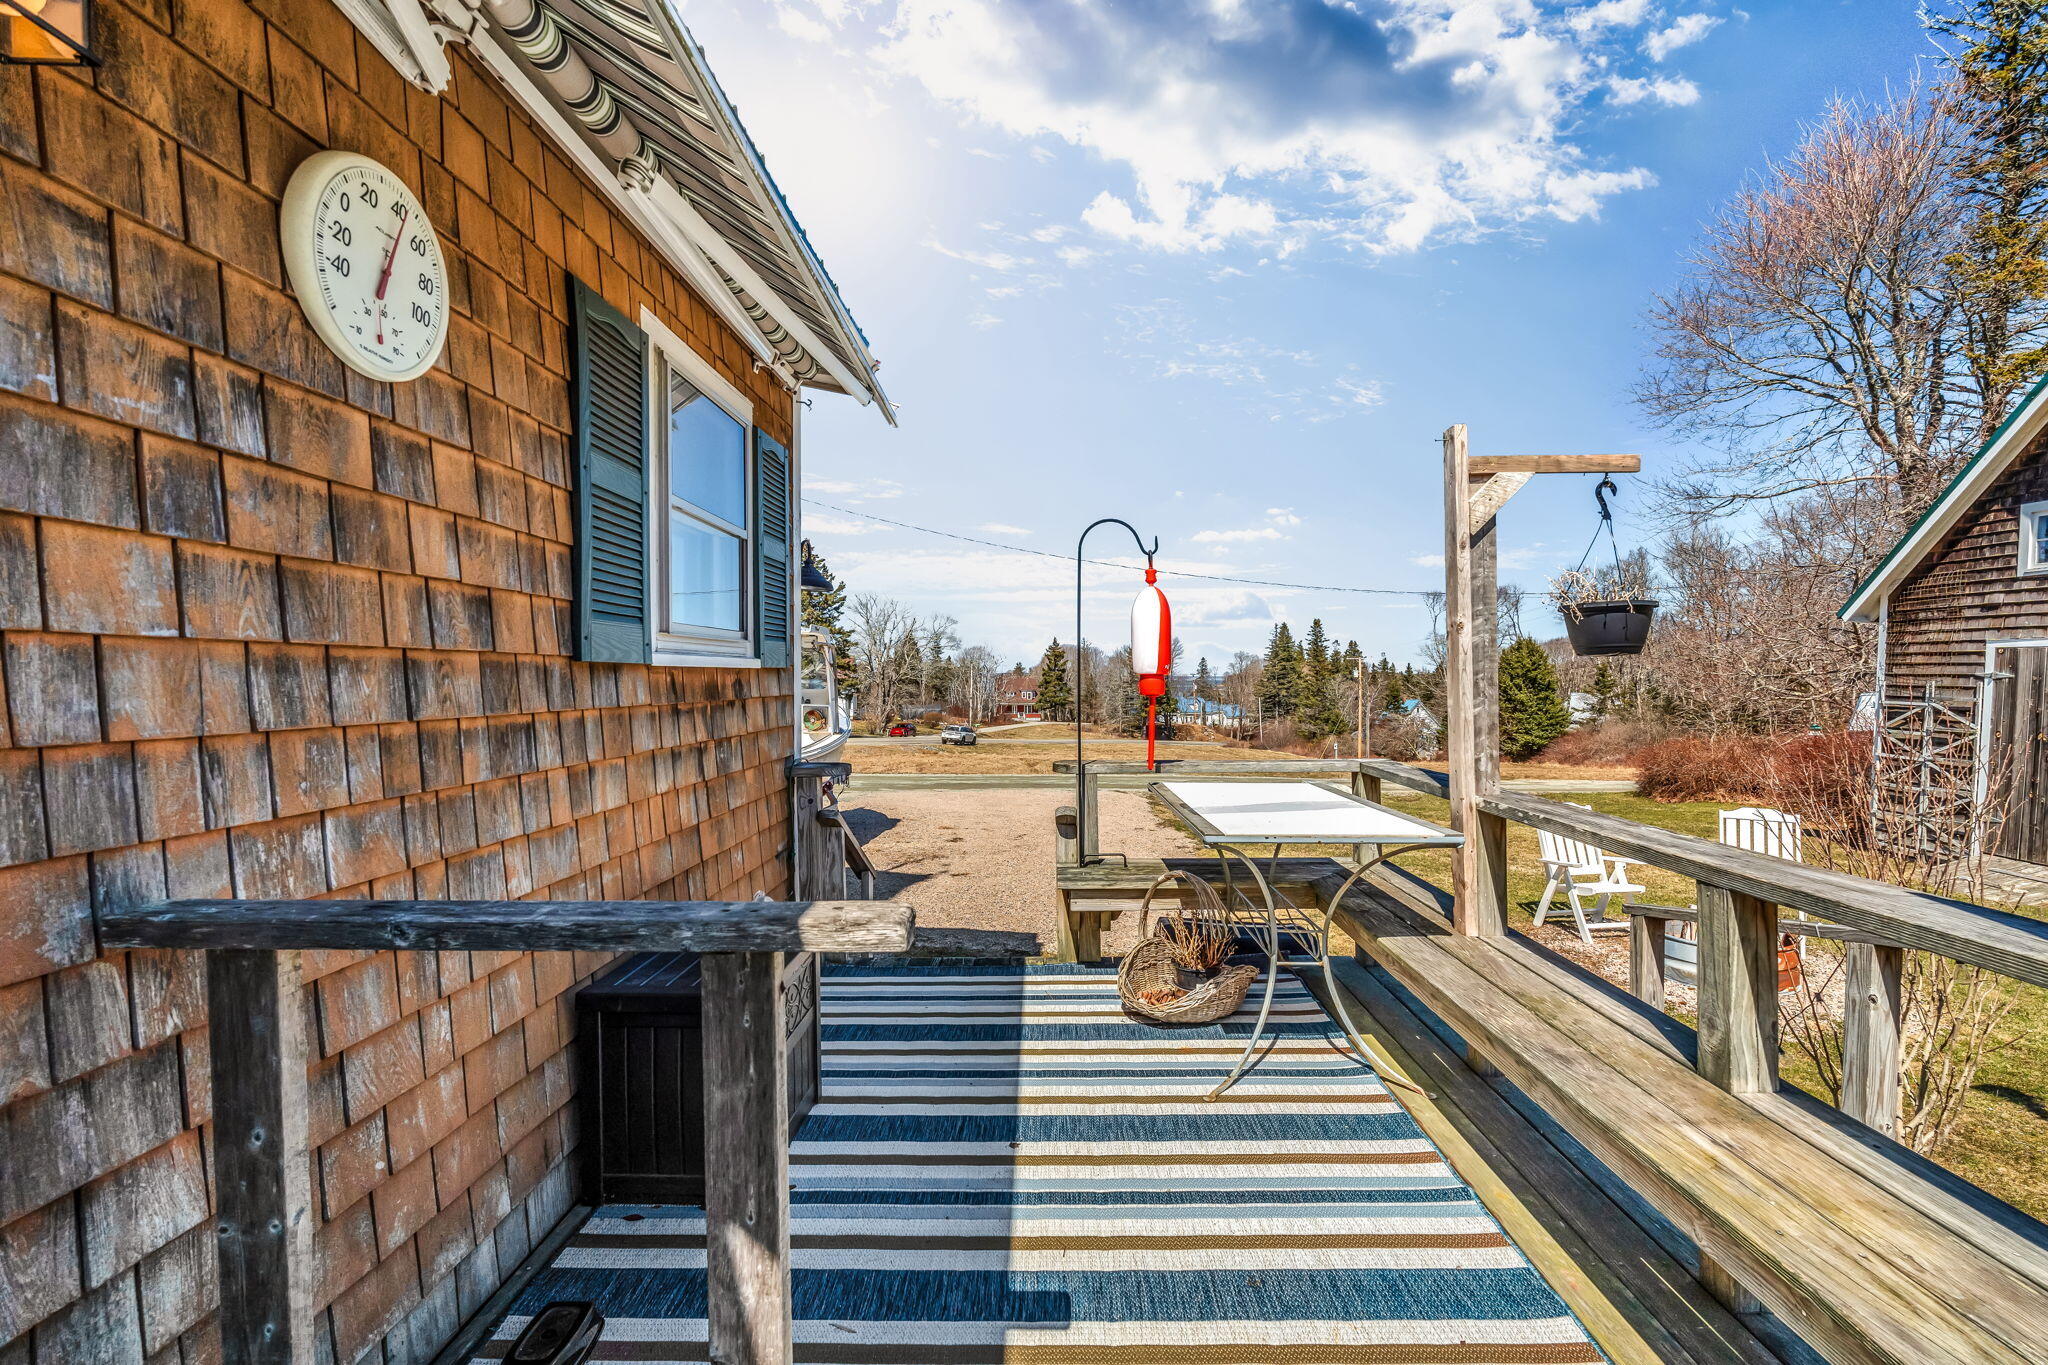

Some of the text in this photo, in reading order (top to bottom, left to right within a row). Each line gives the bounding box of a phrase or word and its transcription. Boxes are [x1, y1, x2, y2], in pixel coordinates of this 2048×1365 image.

[340, 192, 350, 212] 0
[360, 182, 378, 208] 20
[391, 200, 407, 222] 40
[328, 220, 351, 247] -20
[410, 235, 426, 257] 60
[325, 254, 350, 277] -40
[419, 274, 433, 296] 80
[364, 306, 372, 317] 30
[380, 309, 388, 319] 50
[411, 302, 431, 328] 100
[356, 325, 363, 335] 10
[391, 327, 399, 338] 70
